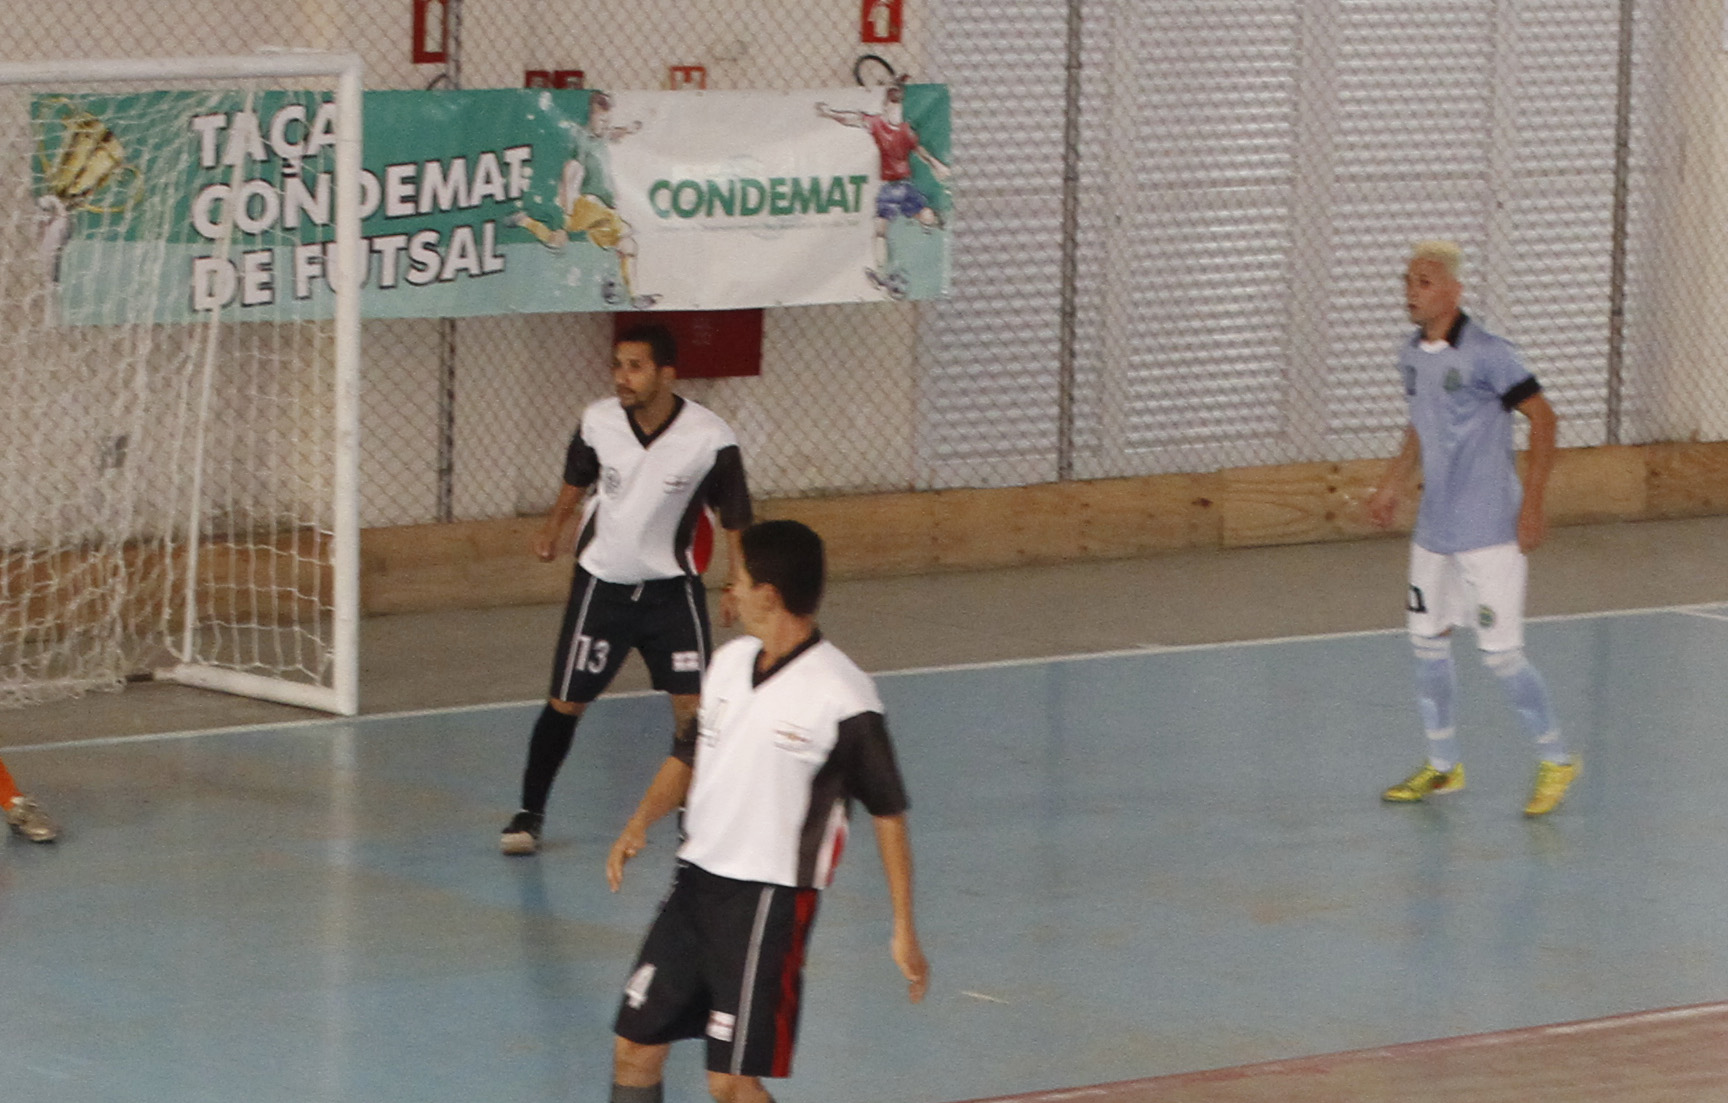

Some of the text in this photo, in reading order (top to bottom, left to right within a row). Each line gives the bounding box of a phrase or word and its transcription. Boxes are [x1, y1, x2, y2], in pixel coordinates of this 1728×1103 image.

[191, 101, 338, 176] TAÇA
[191, 145, 532, 241] CONDEMAT
[649, 174, 869, 219] CONDEMAT
[193, 220, 507, 312] DE FUTSAL
[574, 634, 611, 674] 13
